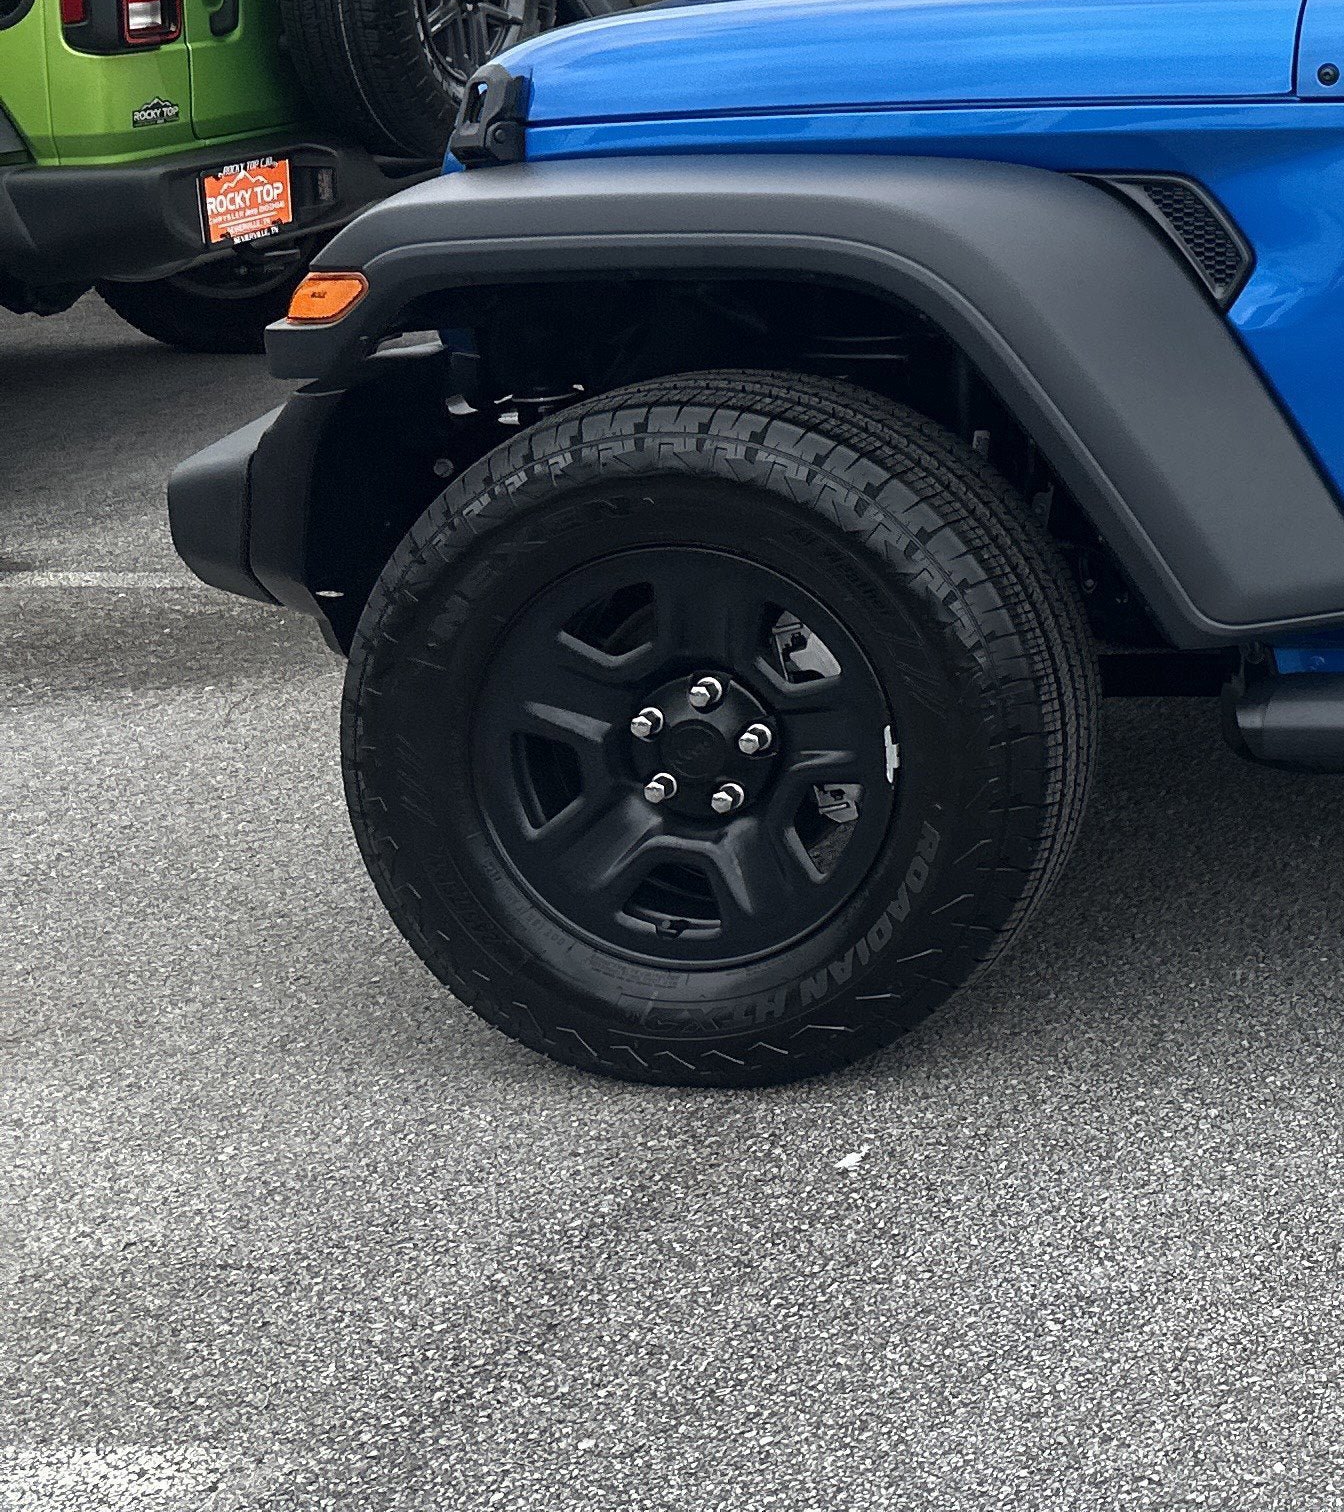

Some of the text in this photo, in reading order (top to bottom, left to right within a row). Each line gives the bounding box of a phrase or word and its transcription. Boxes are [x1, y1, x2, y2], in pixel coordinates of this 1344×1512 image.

[133, 105, 179, 122] ROCKY TOP
[206, 187, 253, 216] ROCKY
[253, 181, 284, 204] TOP
[798, 819, 941, 1009] ROADIAN
